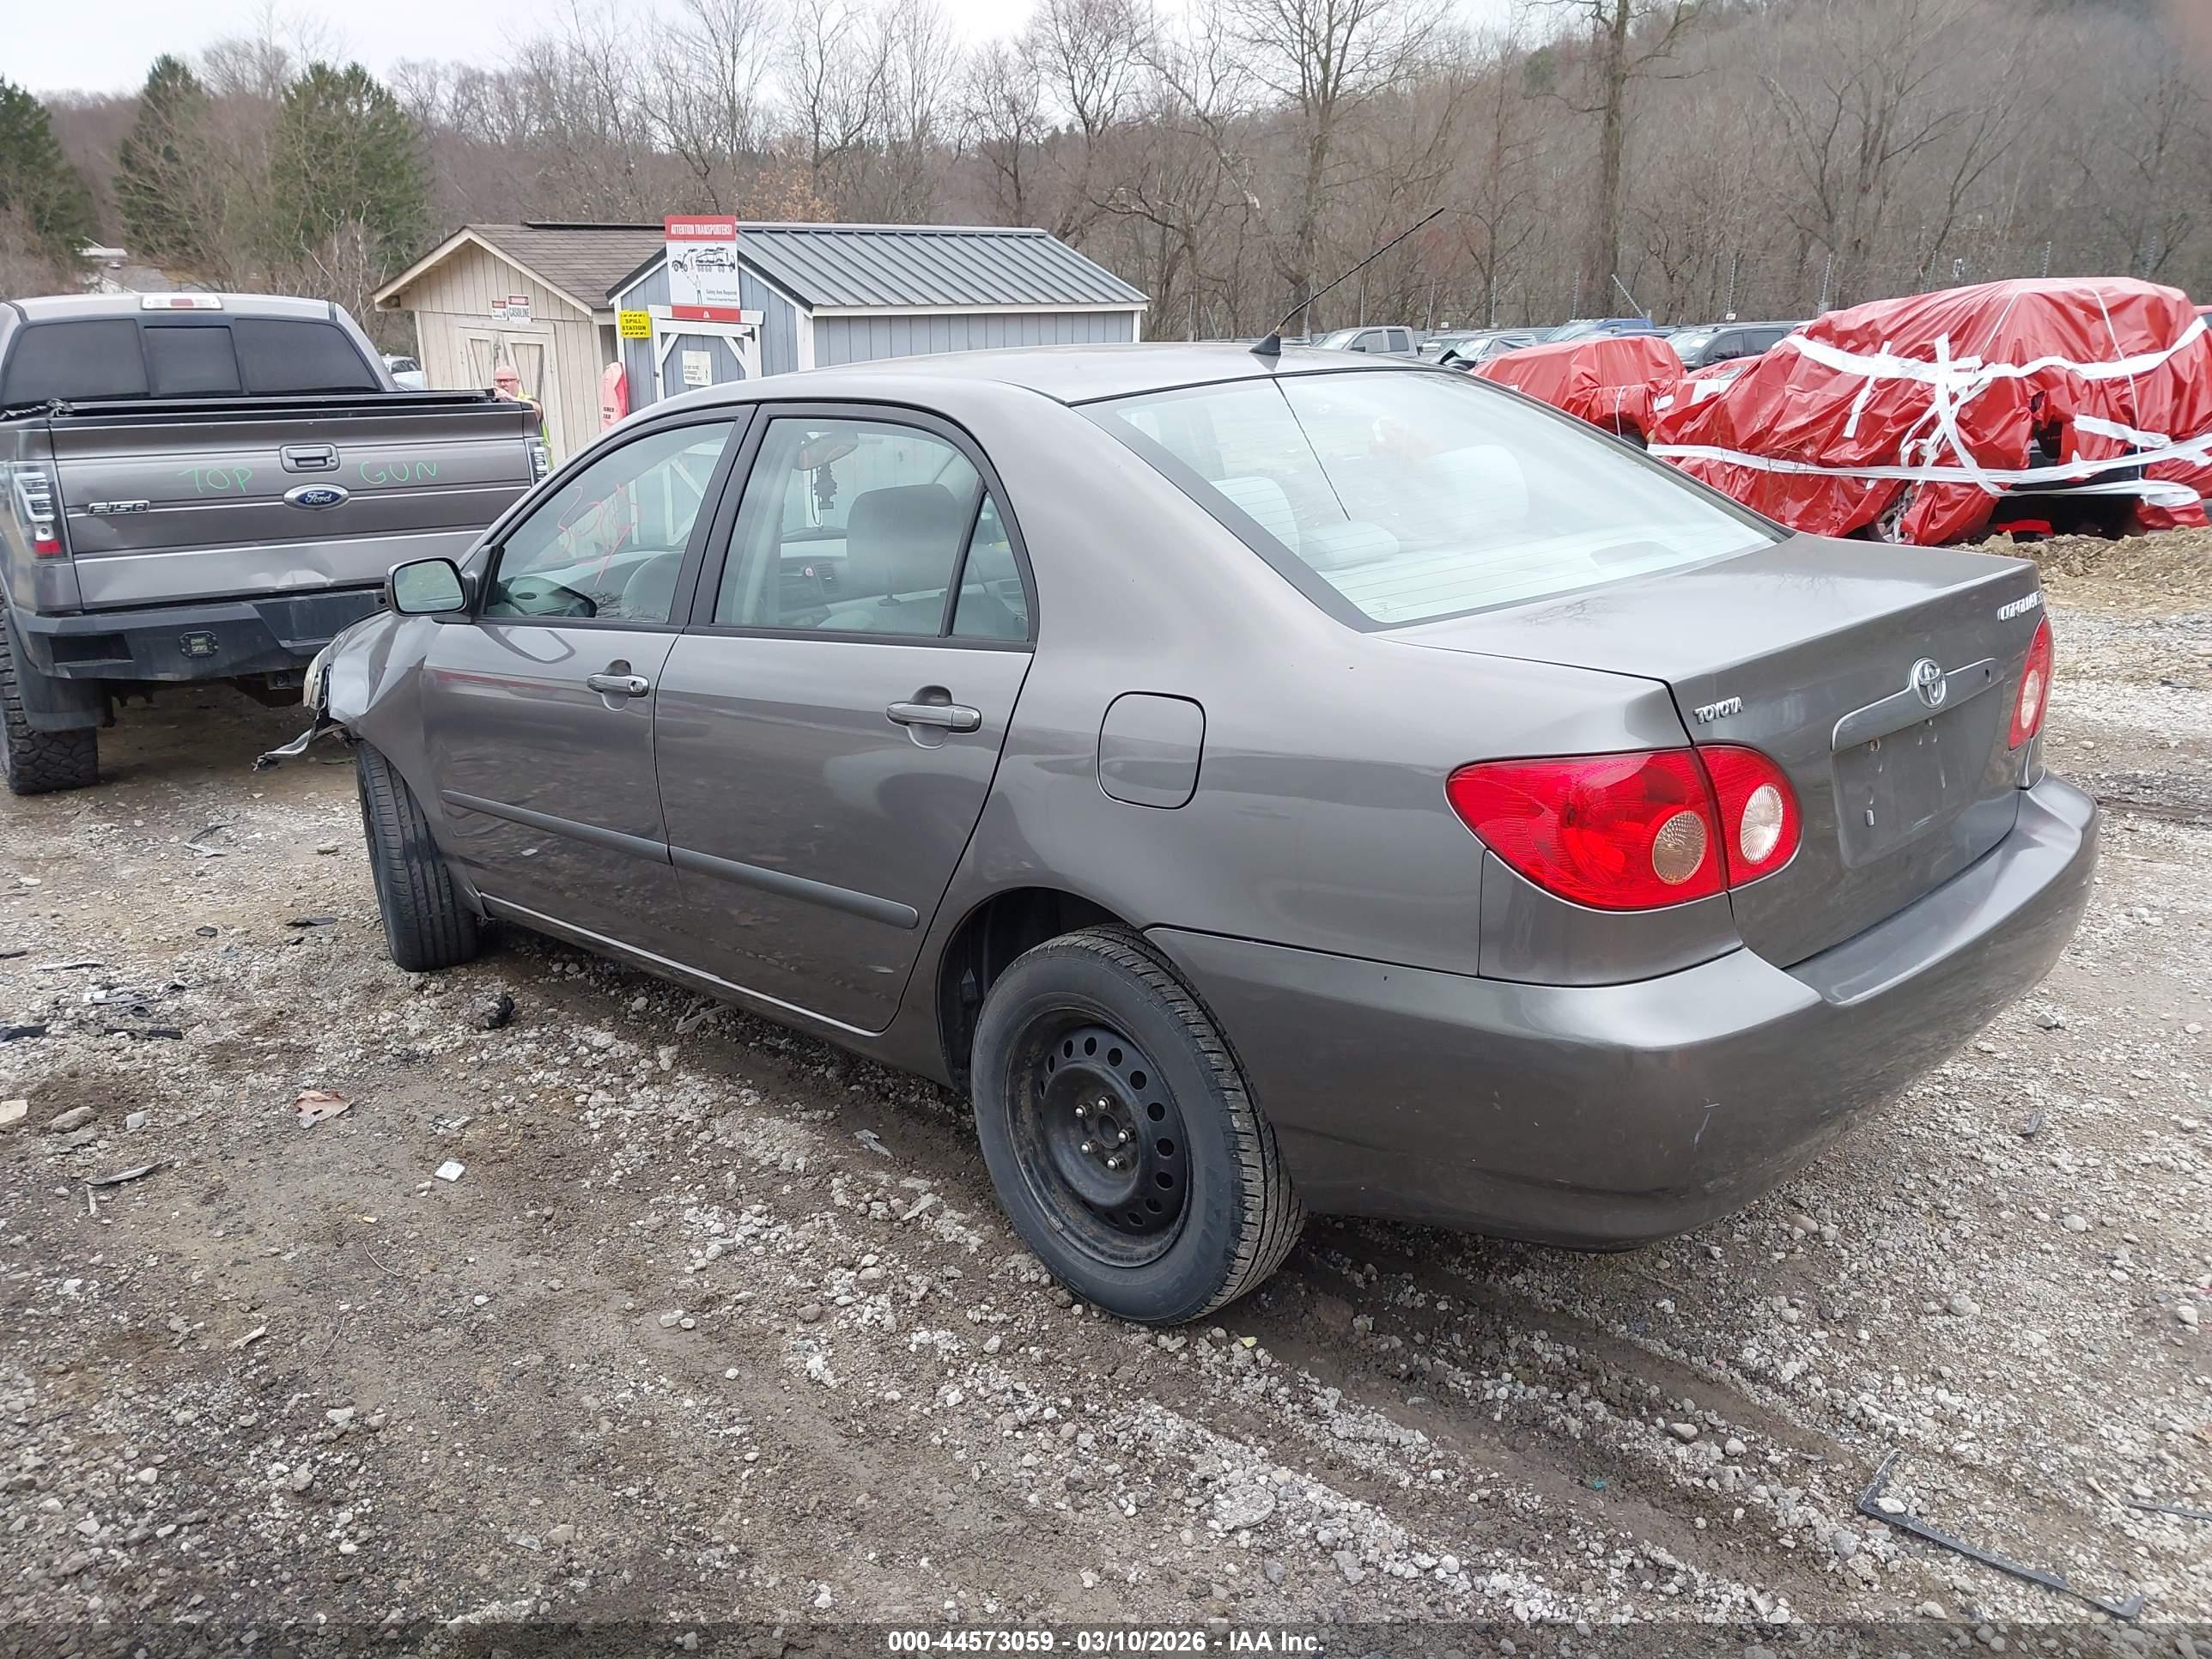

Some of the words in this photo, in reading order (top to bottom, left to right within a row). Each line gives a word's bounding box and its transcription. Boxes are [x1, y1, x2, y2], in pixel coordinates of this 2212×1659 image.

[671, 224, 694, 234] ATTENTION
[179, 467, 252, 494] TOP
[360, 460, 437, 484] GUN
[305, 490, 333, 504] Ford
[1692, 696, 1744, 725] TOYOTA
